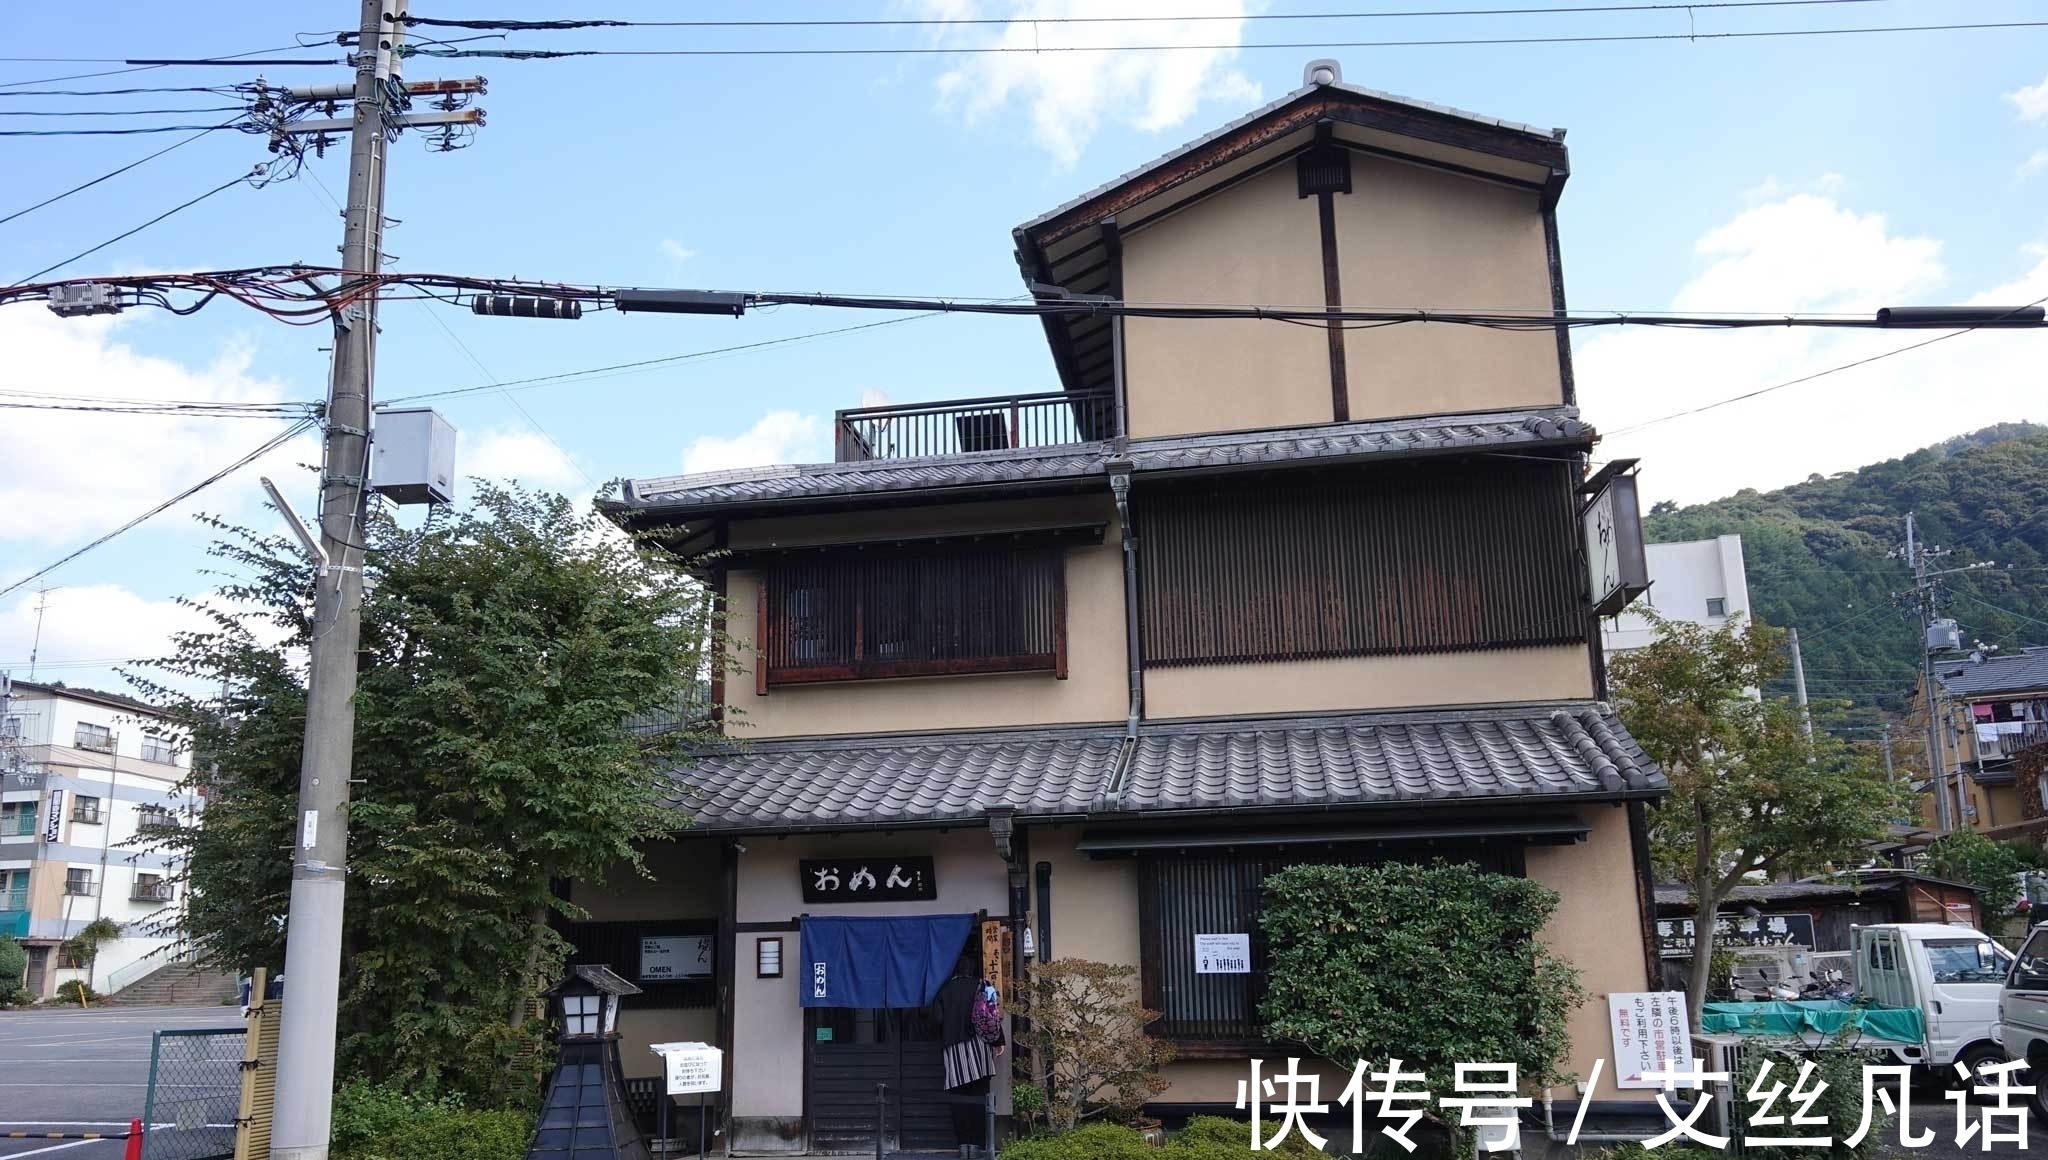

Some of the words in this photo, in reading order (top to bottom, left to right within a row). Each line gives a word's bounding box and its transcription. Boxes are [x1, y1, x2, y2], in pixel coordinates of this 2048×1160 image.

[814, 864, 912, 891] おめん
[816, 965, 825, 996] おめん
[1618, 1008, 1631, 1048] 無料です
[1635, 997, 1652, 1071] もご利用下さい
[1650, 996, 1667, 1081] 左隣の市営駐車
